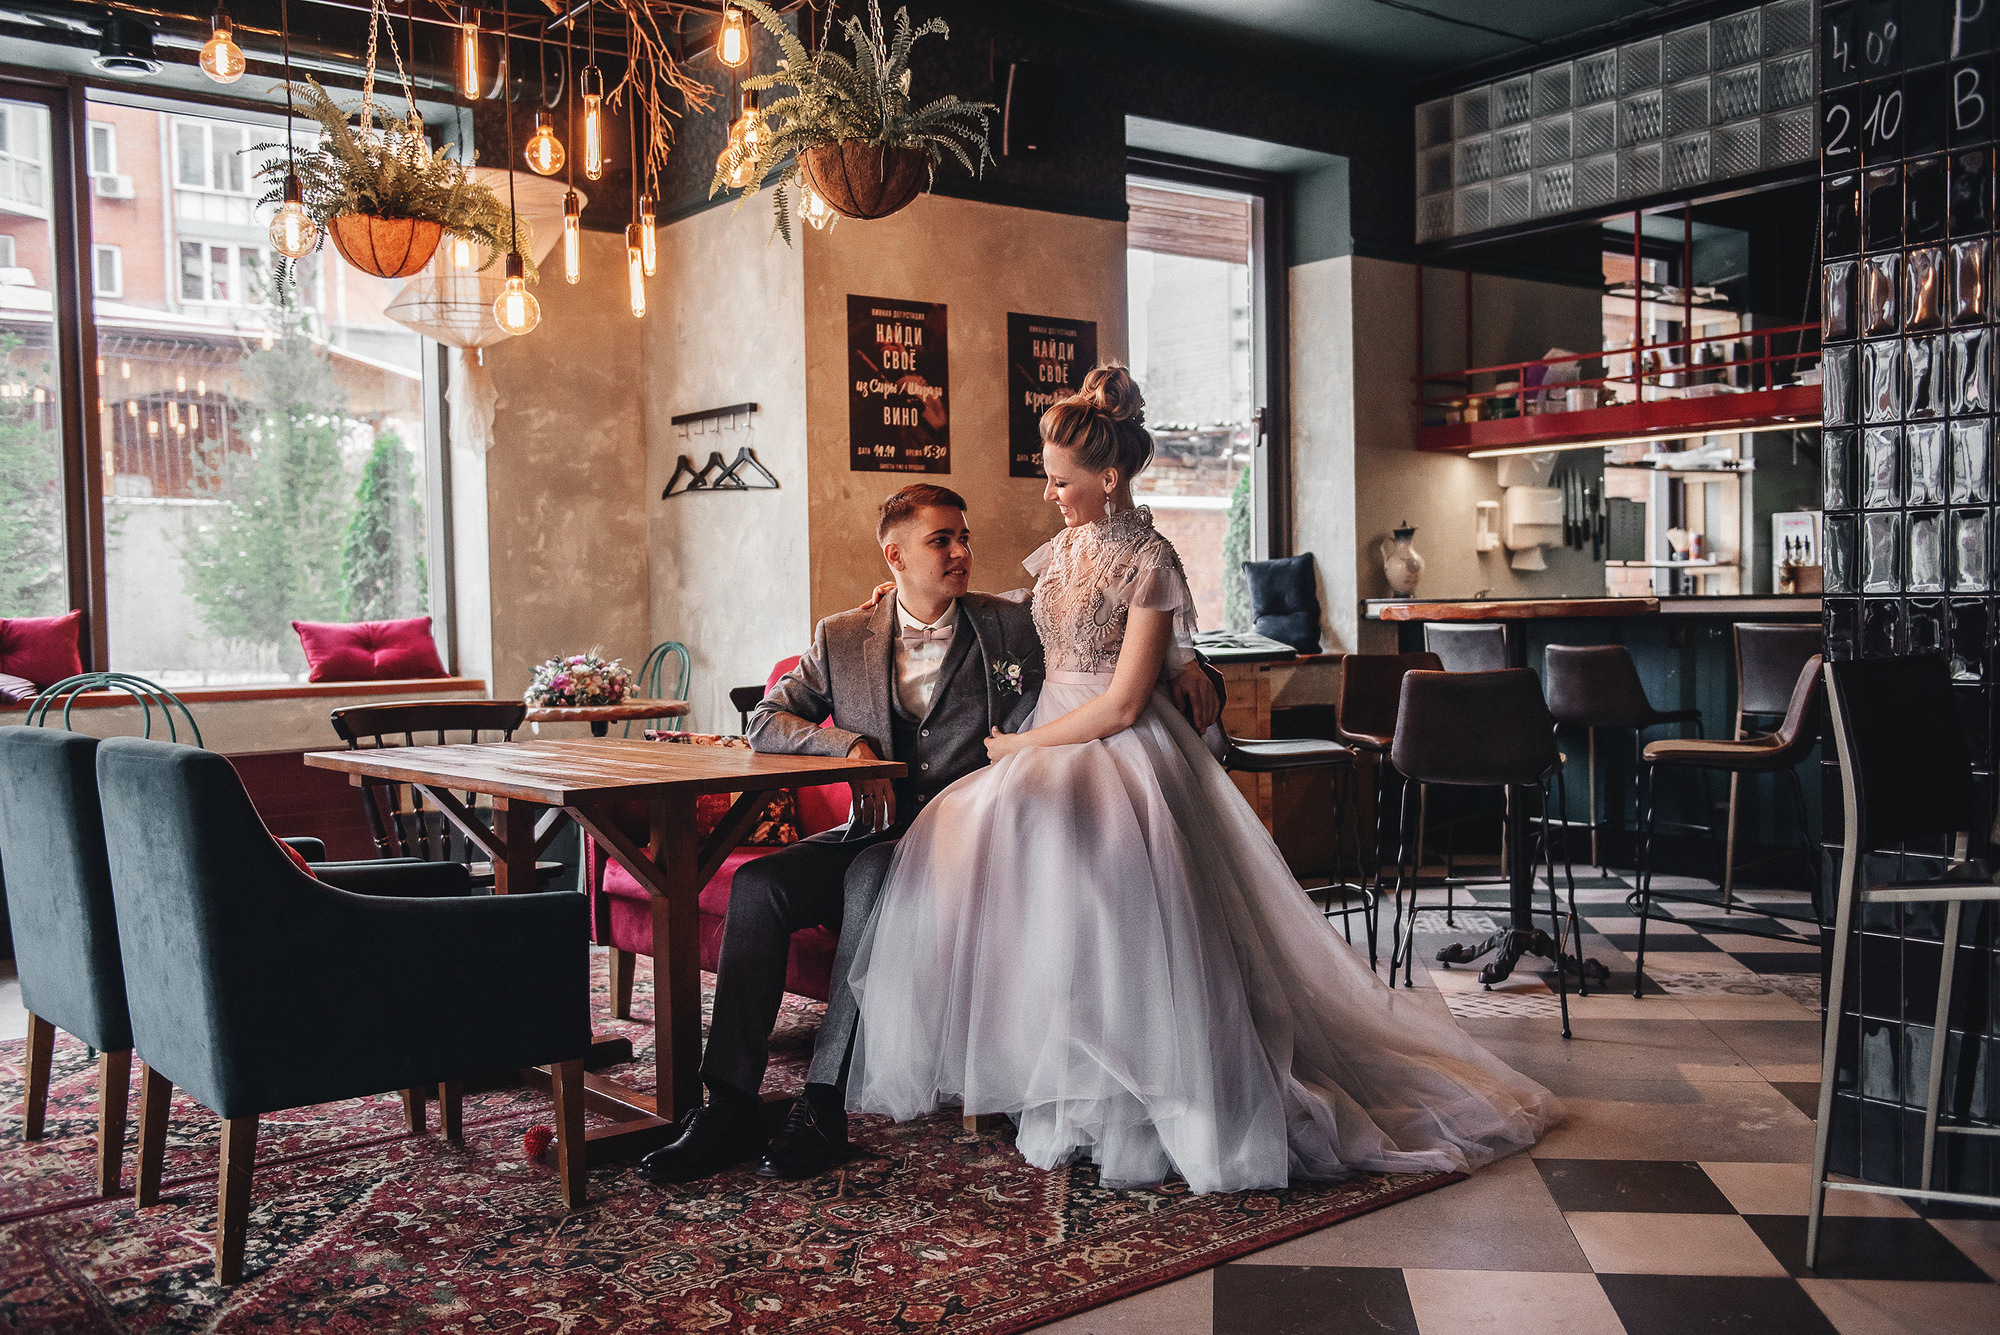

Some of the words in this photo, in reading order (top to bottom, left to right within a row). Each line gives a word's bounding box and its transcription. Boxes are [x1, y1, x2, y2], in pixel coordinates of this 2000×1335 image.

[876, 322, 923, 347] НАЙДИ
[883, 349, 917, 371] СВОЁ
[1033, 338, 1075, 361] НАЙДИ
[1038, 364, 1069, 384] СВОЁ
[883, 406, 919, 427] ВИНО
